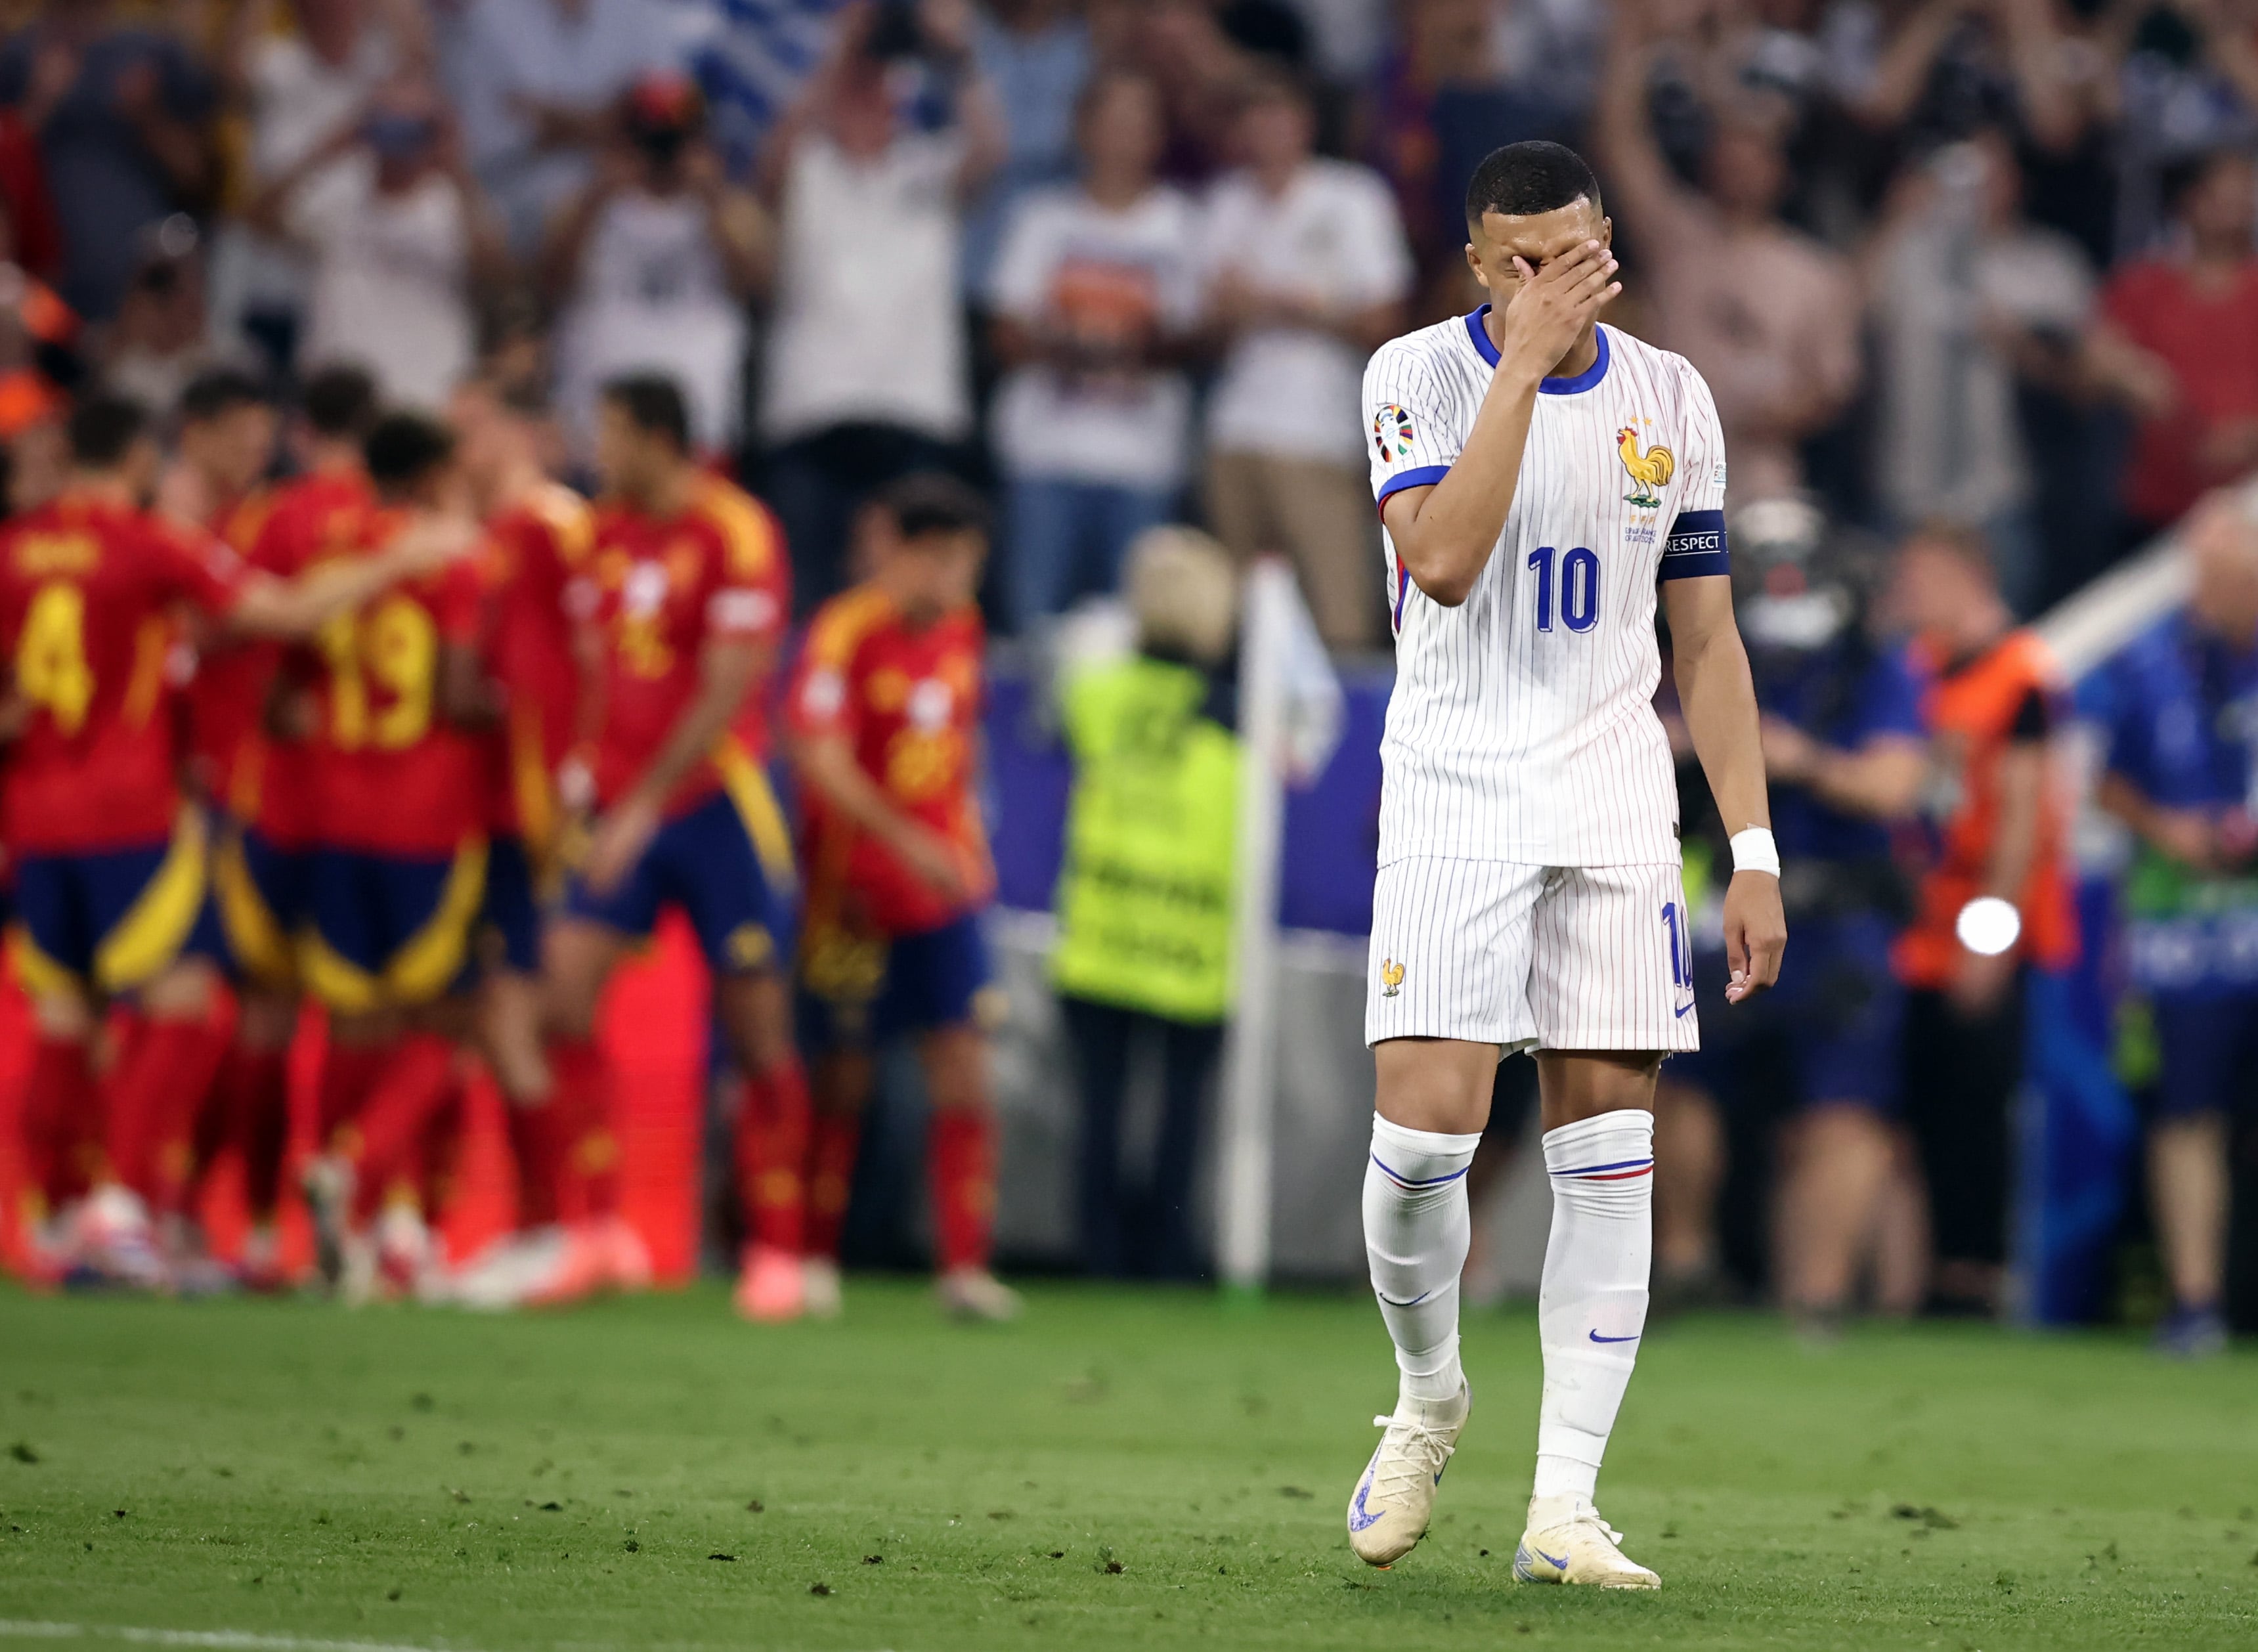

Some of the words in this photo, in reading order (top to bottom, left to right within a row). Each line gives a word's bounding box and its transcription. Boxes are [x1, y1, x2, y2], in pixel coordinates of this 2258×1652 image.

[1664, 536, 1719, 552] RESPECT
[1529, 546, 1601, 634] 10
[18, 583, 96, 739] 4
[322, 594, 435, 750] 19
[1662, 902, 1693, 991] 10
